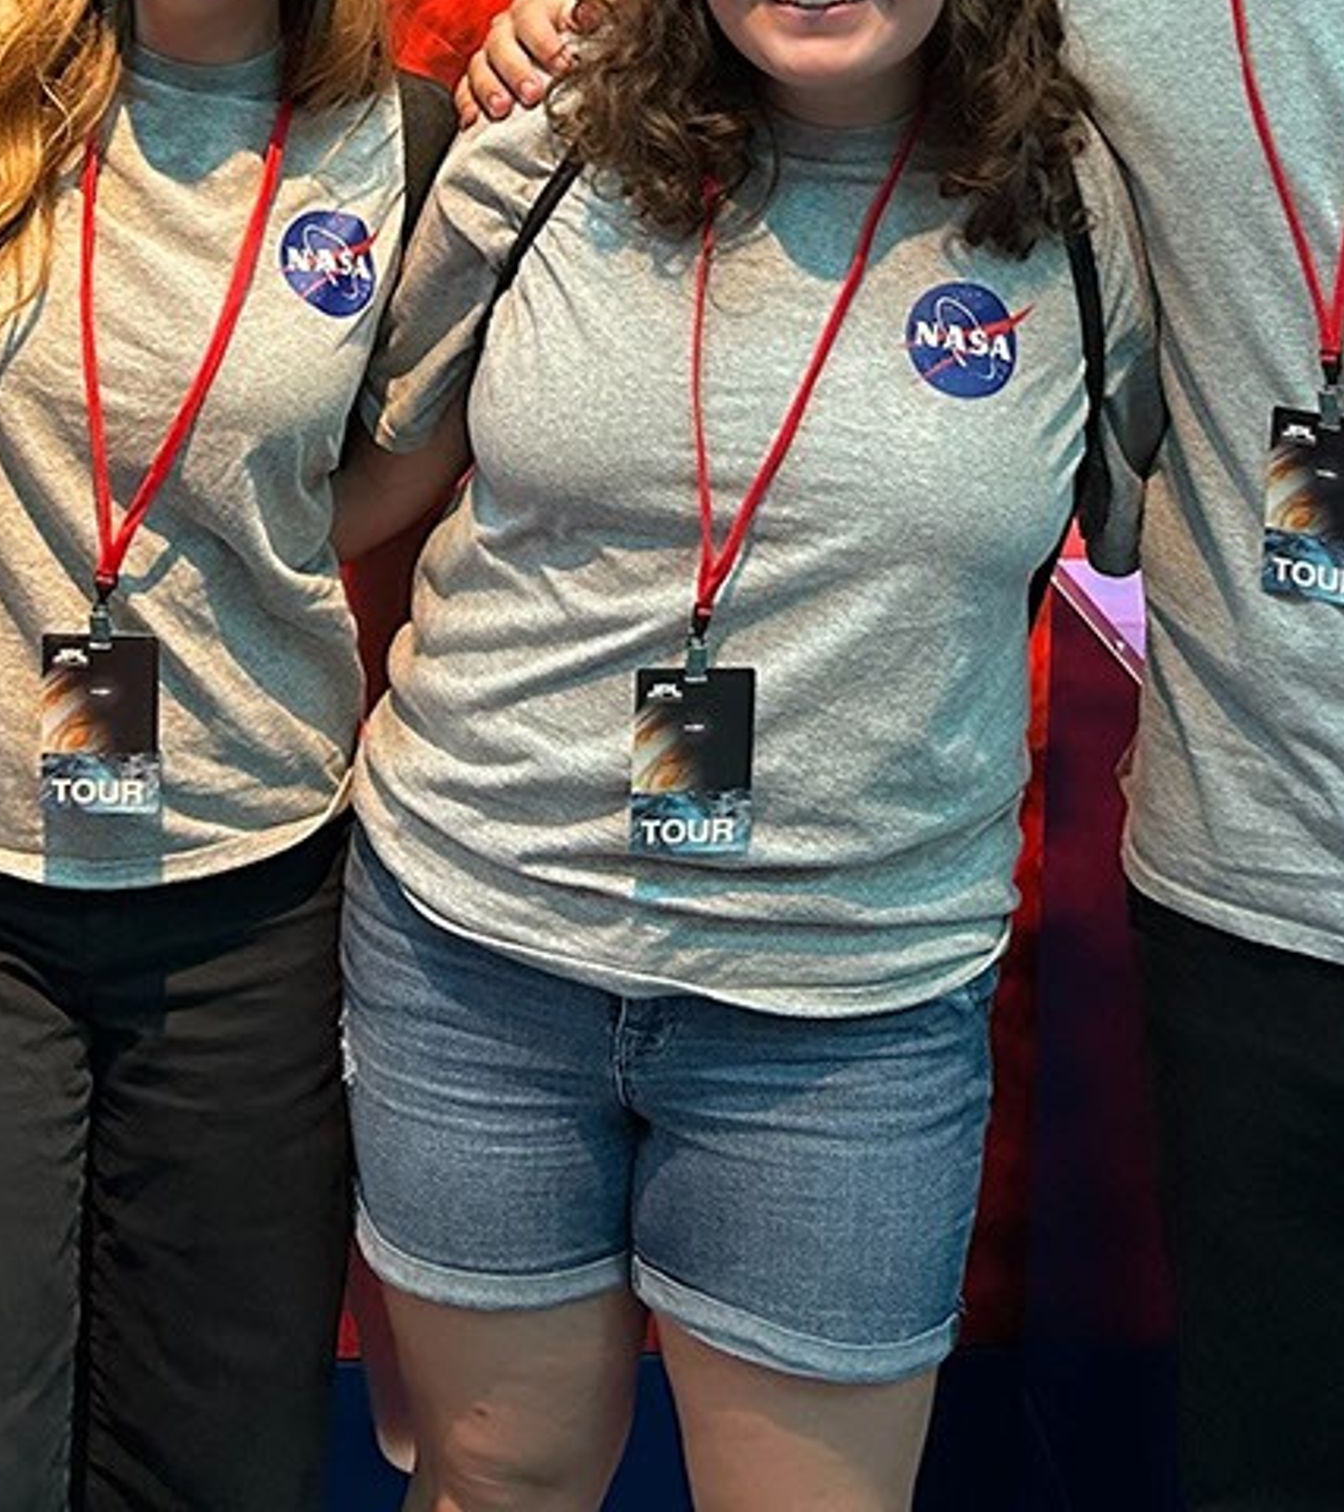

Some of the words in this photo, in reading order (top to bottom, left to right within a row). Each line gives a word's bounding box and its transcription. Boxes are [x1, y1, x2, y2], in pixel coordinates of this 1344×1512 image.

[286, 245, 372, 281] NASA
[914, 320, 1012, 362] NASA
[51, 777, 145, 805] TOUR
[640, 818, 735, 844] TOUR
